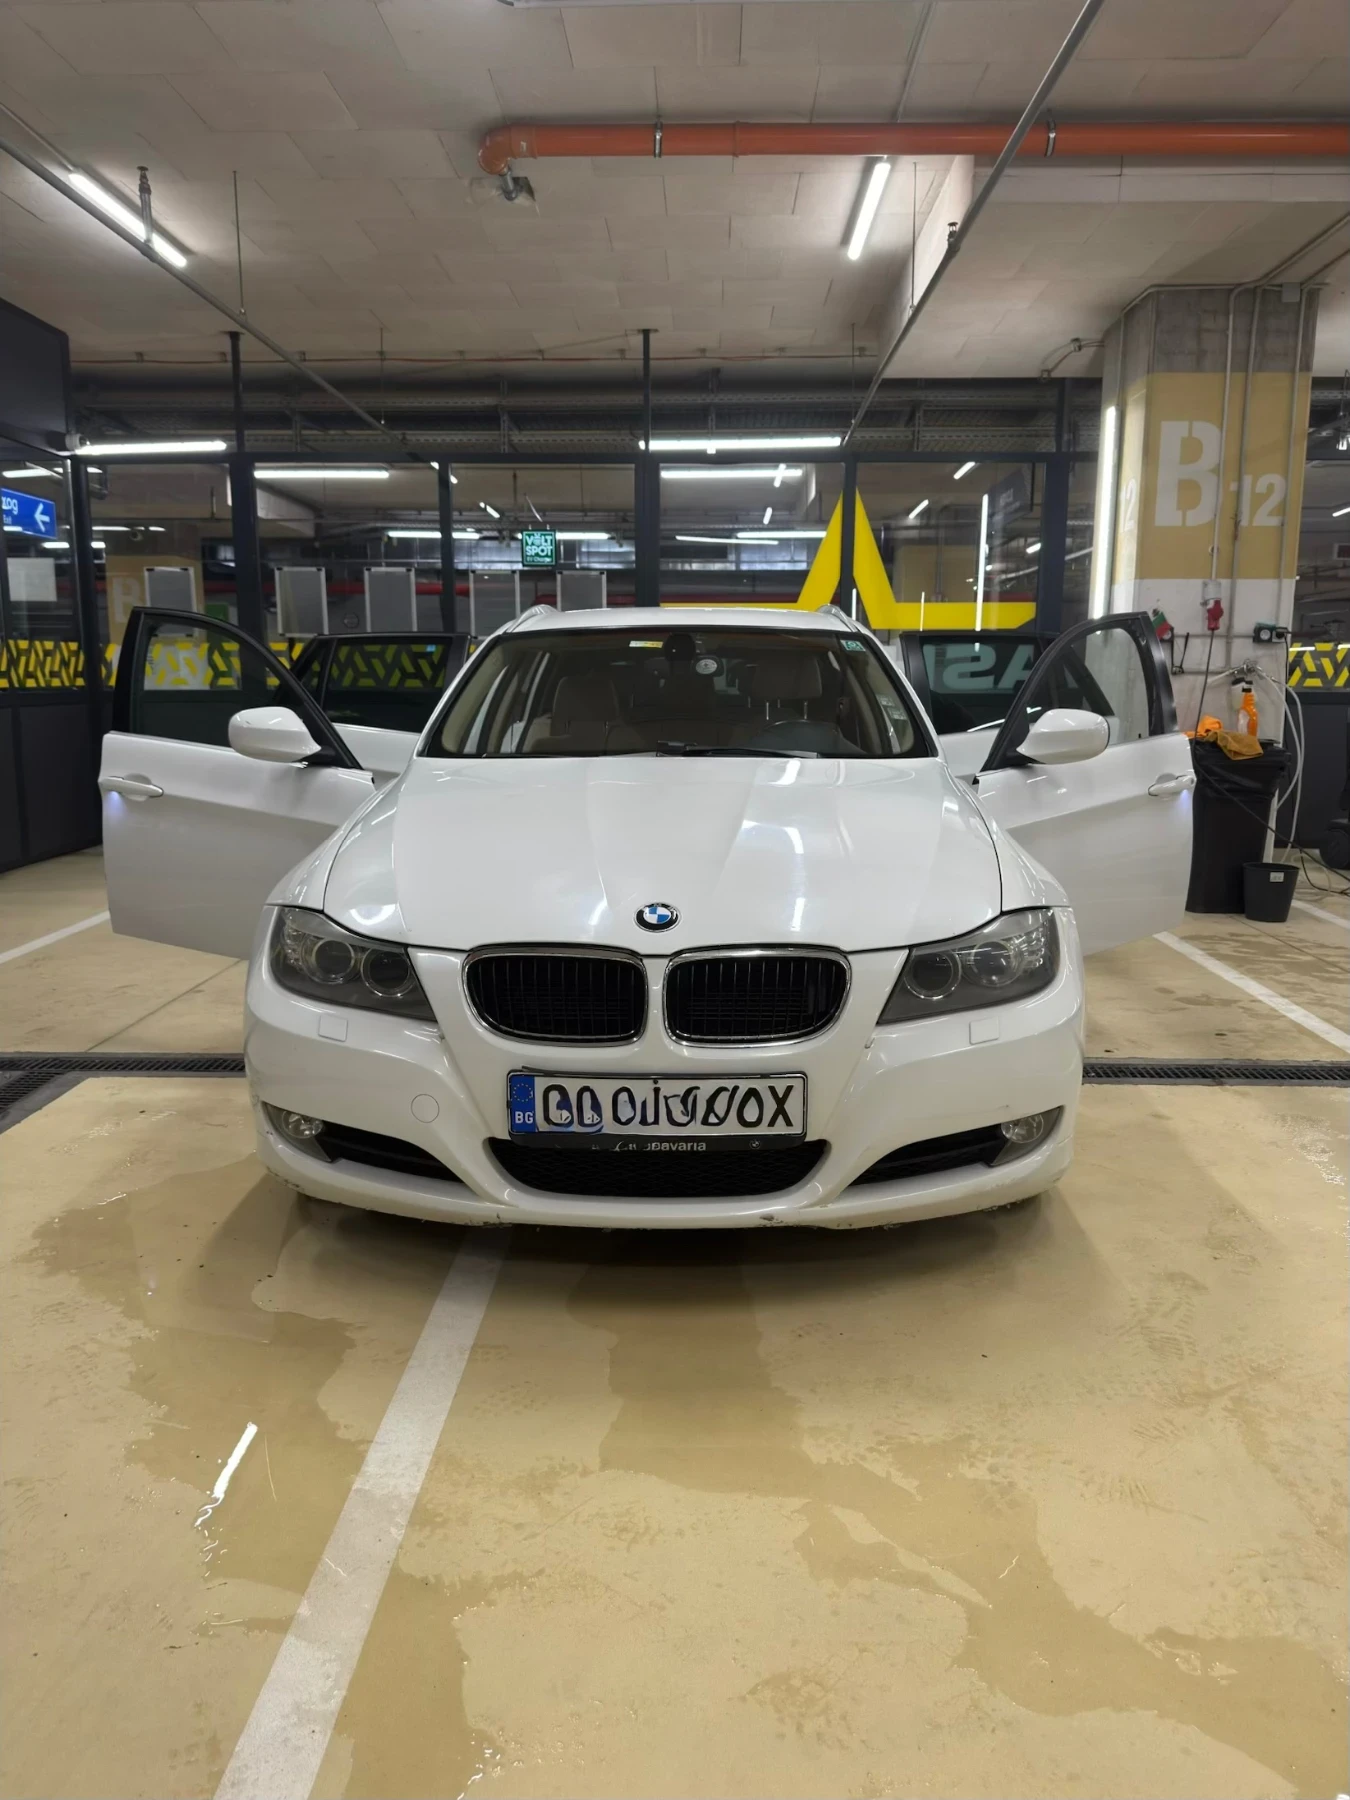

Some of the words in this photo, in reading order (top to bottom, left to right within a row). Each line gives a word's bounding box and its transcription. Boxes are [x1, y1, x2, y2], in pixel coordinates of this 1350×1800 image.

[1155, 420, 1222, 527] B
[1229, 473, 1287, 527] 12
[525, 545, 553, 556] SPOT
[514, 1111, 534, 1124] BG
